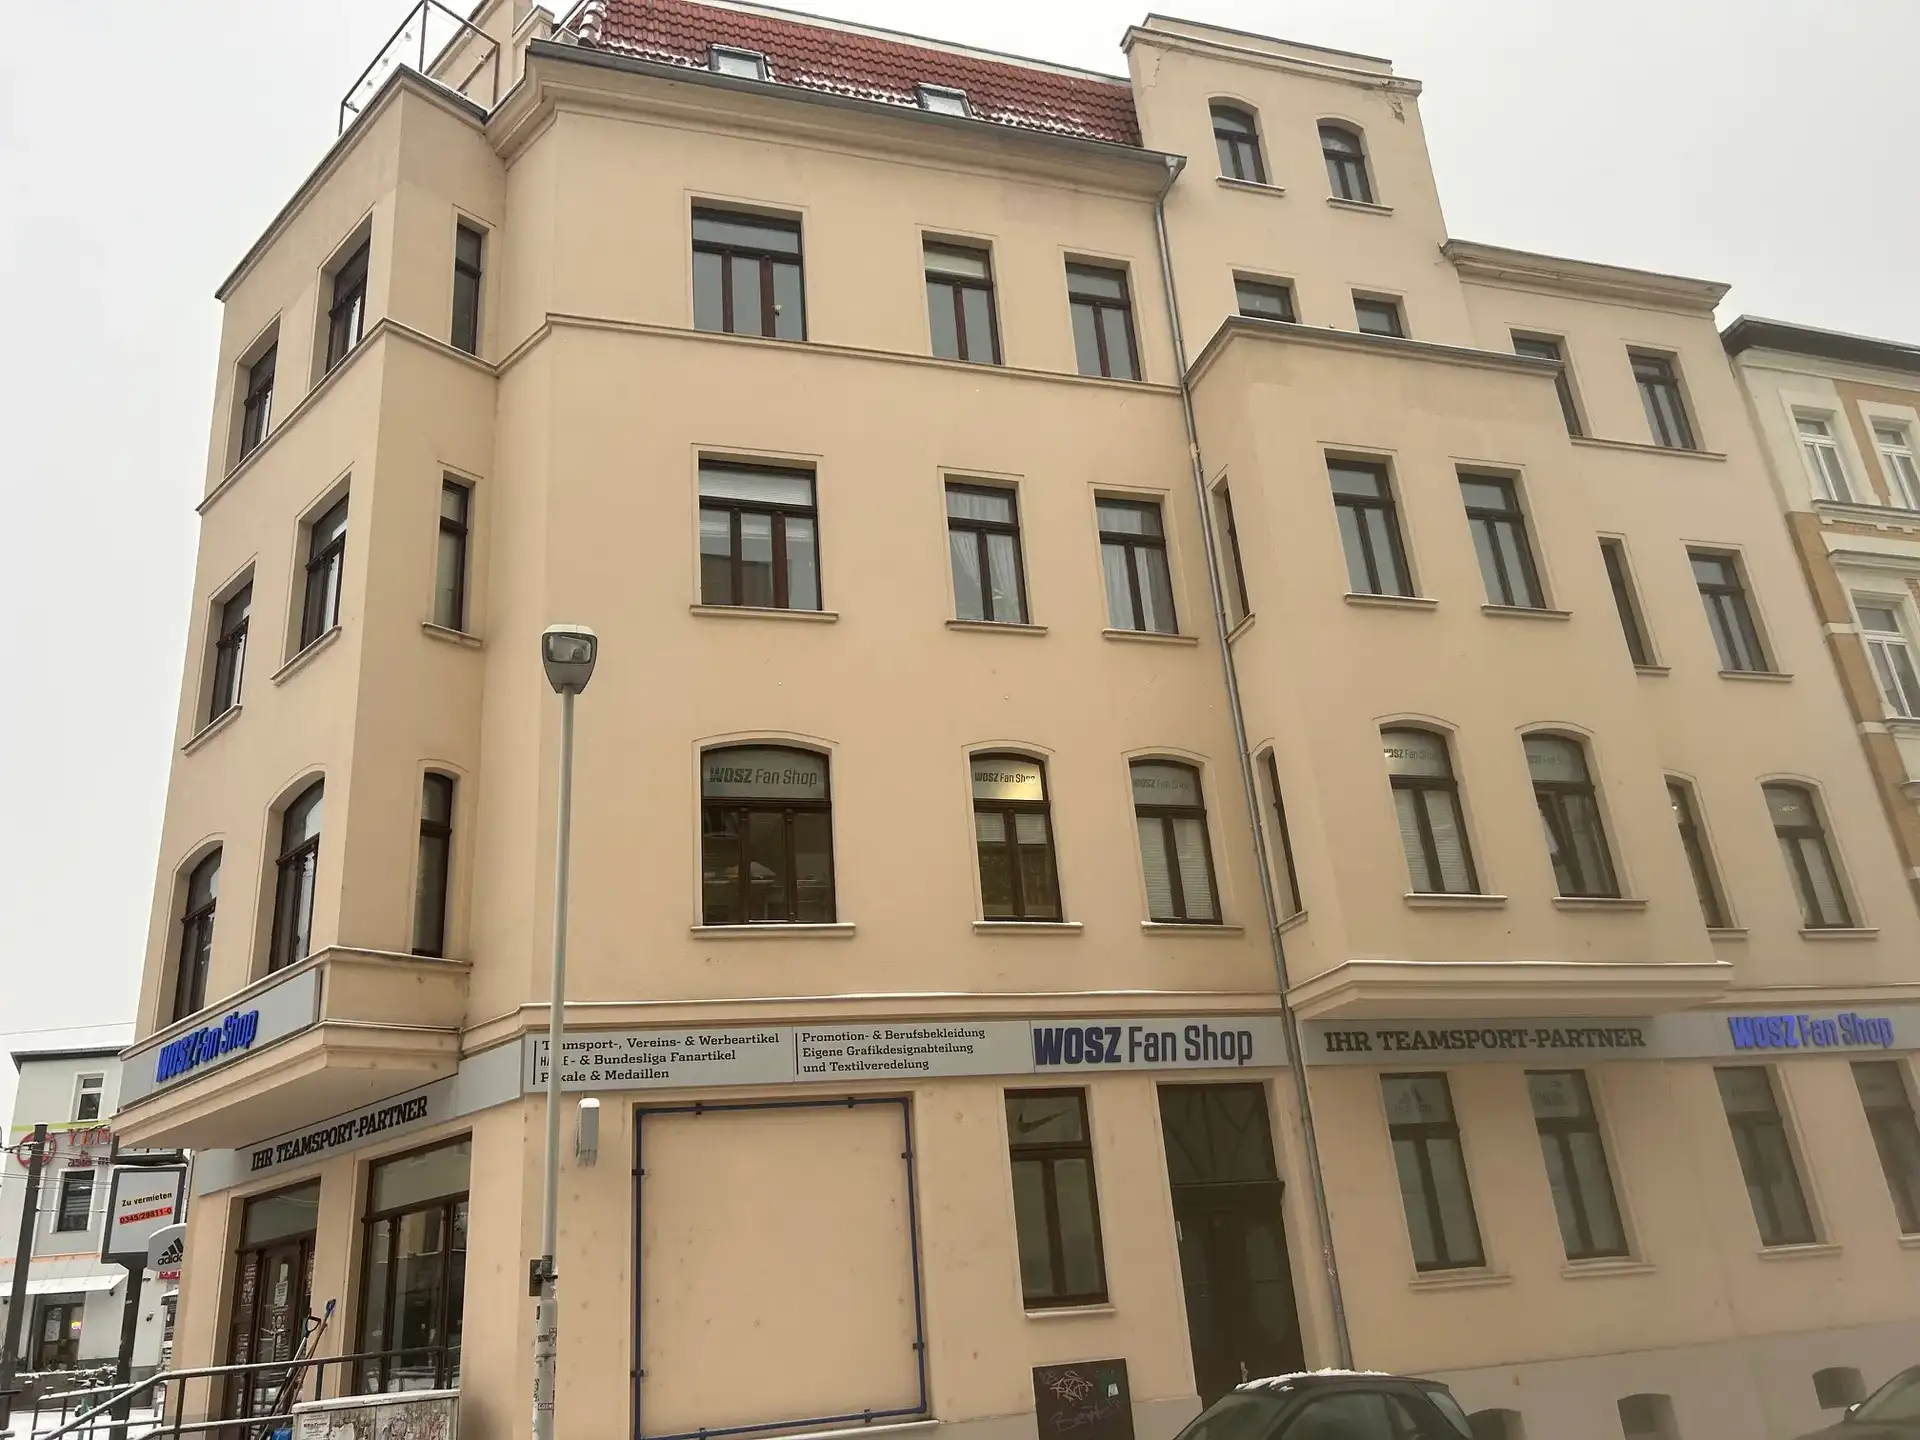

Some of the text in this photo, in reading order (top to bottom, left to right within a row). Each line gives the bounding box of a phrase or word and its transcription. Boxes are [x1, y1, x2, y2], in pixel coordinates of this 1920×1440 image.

[709, 766, 818, 787] WOSZ Fan Shop
[974, 771, 999, 783] WOSZ
[1000, 772, 1014, 783] Fan
[802, 1027, 986, 1043] Promotion- & Berufsbekleidung
[1728, 1012, 1895, 1050] WOSZ Fan Shop
[156, 1010, 259, 1083] WOSZ Fan Shop
[541, 1033, 780, 1052] Tamsport-, Vereins- & Werbeartikel
[1033, 1024, 1253, 1066] WOSZ Fan Shop
[1324, 1028, 1647, 1052] IHR TEAMSPORT-PARTNER
[579, 1055, 590, 1066] &
[594, 1053, 667, 1066] Bundesliga
[670, 1049, 737, 1062] Fanartikel
[802, 1043, 974, 1060] Eigene Grafikdesignabteilung
[803, 1059, 930, 1073] und Textilveredelung
[540, 1068, 670, 1082] Pkale & Medaillen
[251, 1096, 428, 1171] IHR TEAMSPORT-PARTNER
[121, 1192, 173, 1208] Zu vermieten
[157, 1253, 183, 1266] adid
